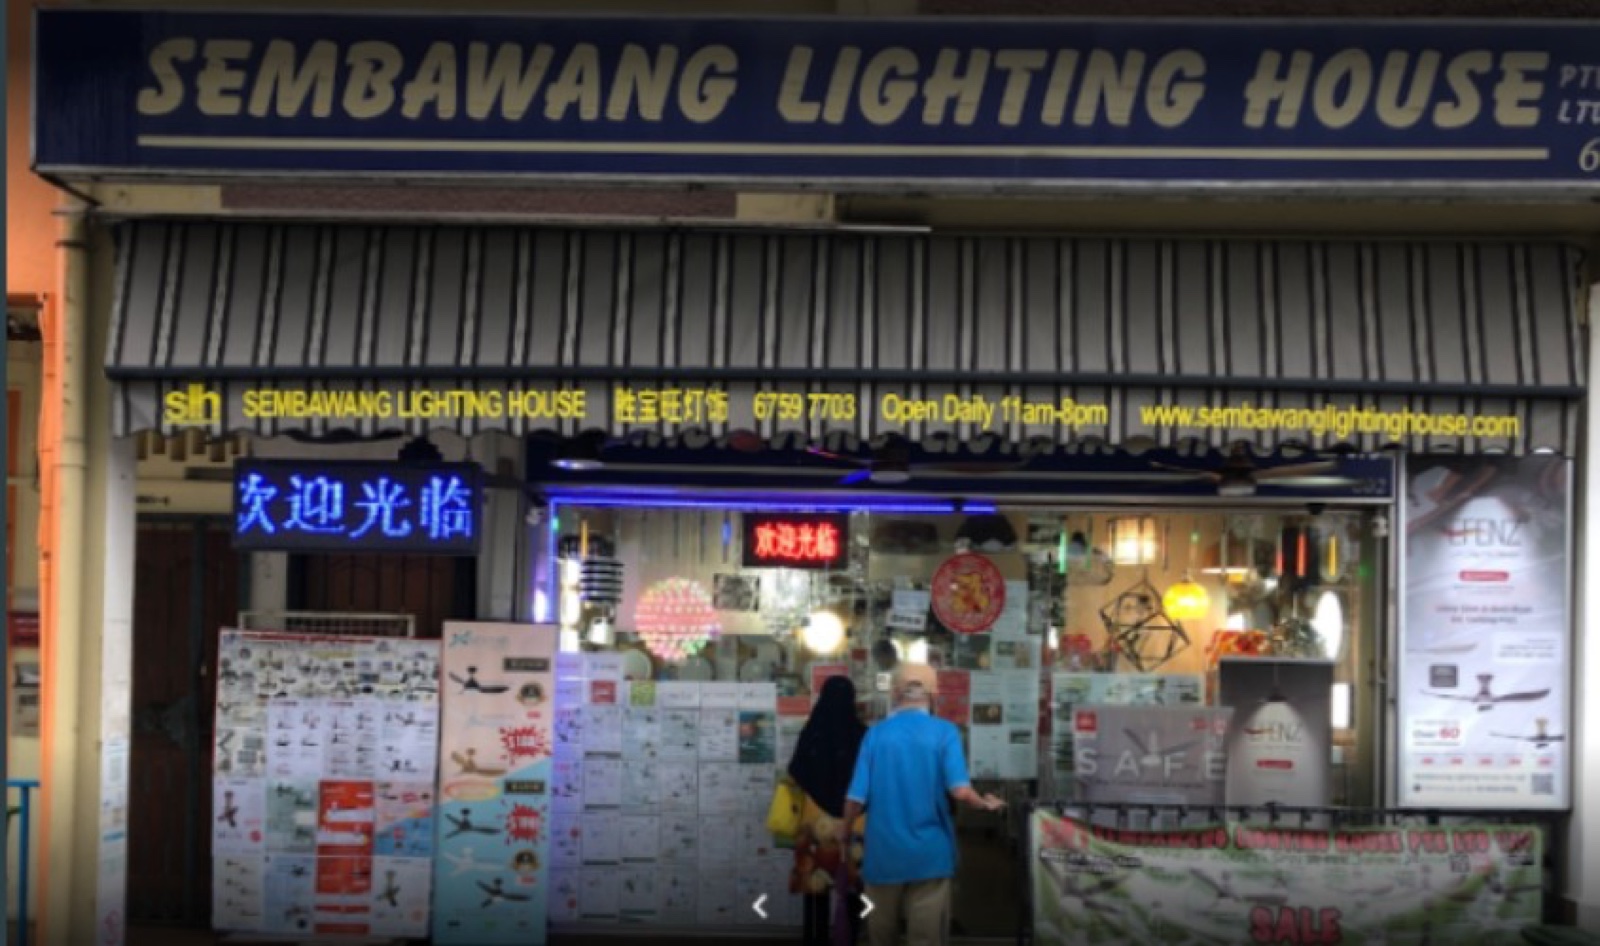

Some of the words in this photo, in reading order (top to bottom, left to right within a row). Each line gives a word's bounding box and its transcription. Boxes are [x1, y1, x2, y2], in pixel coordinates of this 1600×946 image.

[137, 38, 738, 122] SEMBAWANG
[776, 46, 1206, 127] LIGHTING
[1243, 50, 1549, 129] HOUSE
[1559, 65, 1600, 90] PT
[164, 383, 221, 425] slh
[242, 389, 393, 418] SEMBAWANG
[397, 390, 504, 418] LIGHTING
[508, 390, 586, 418] HOUSE
[752, 393, 803, 420] 6759
[808, 393, 856, 420] 7703
[881, 394, 938, 428] Open
[943, 395, 994, 430] Daily
[1001, 395, 1109, 427] 11am-8pm
[1140, 403, 1520, 440] www.sembawanglightinghouse.com
[1075, 748, 1226, 780] SAFE
[1250, 906, 1342, 945] SALE
